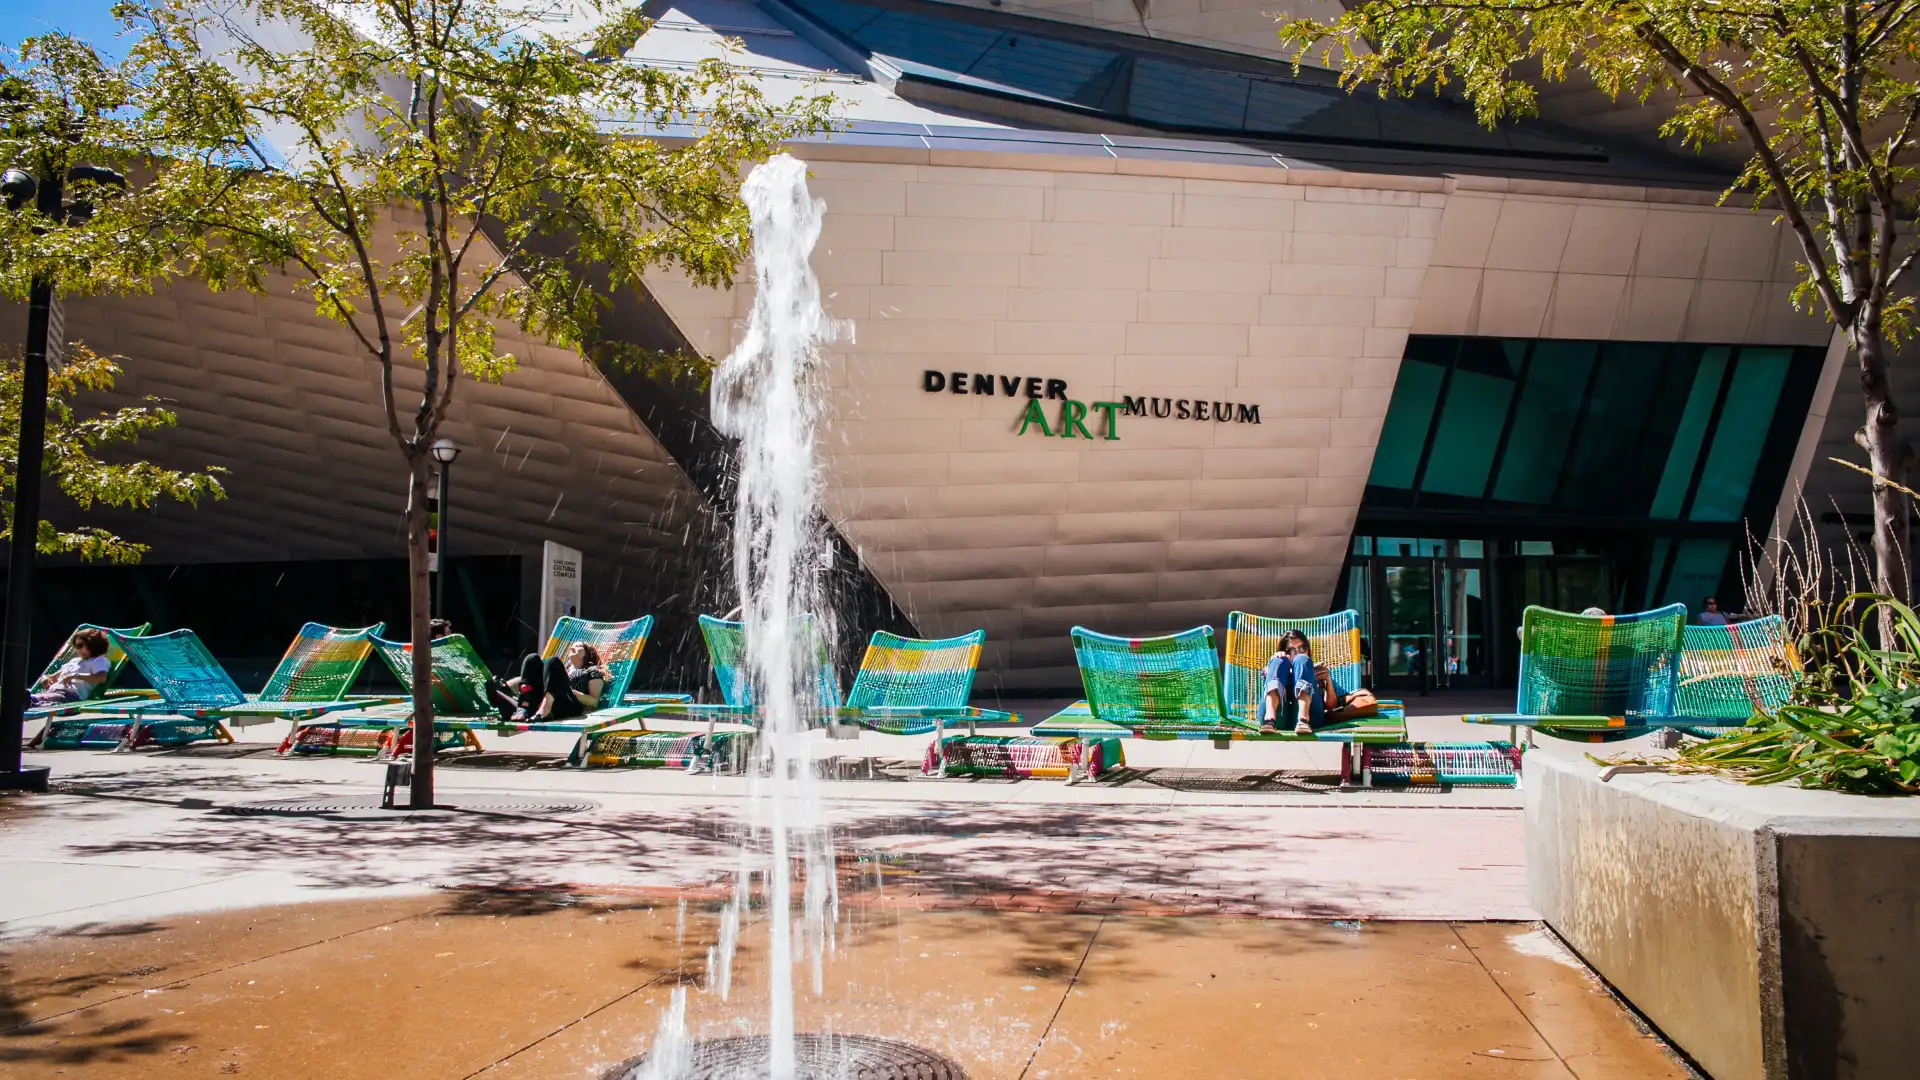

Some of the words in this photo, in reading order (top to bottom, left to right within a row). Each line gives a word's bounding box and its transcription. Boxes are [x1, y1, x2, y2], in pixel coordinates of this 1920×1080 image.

[923, 370, 1068, 400] DENVER
[1018, 399, 1127, 440] ART
[1123, 396, 1262, 424] MUSEUM
